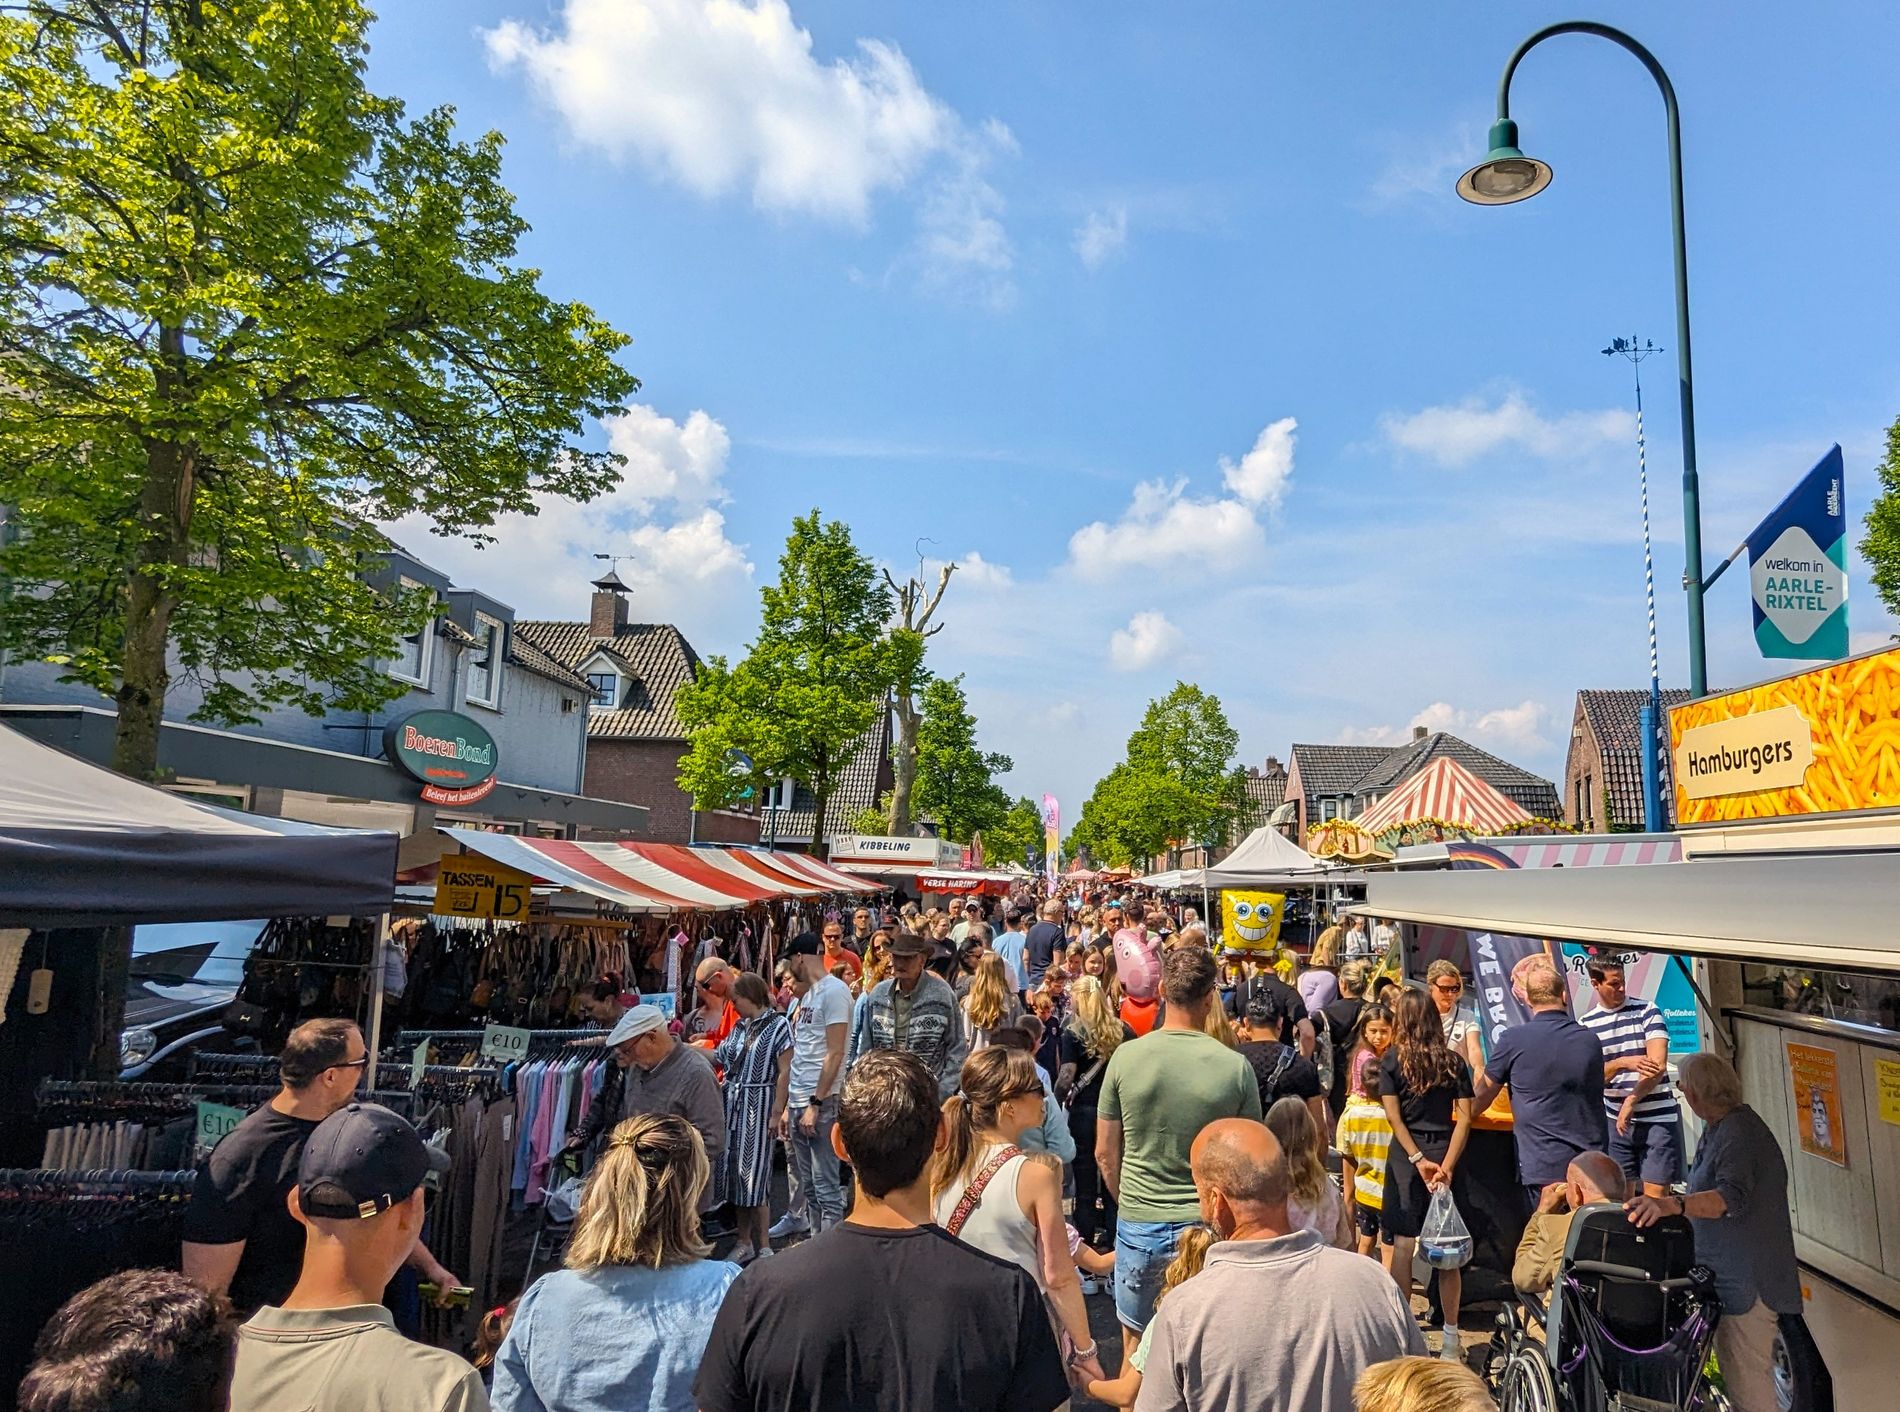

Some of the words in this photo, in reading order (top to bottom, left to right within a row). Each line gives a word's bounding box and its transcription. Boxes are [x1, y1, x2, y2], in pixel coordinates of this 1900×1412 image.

[1765, 558, 1811, 573] welkom
[1813, 560, 1824, 573] in
[1765, 577, 1834, 594] AARLE-
[1765, 594, 1828, 611] RIXTEL
[404, 725, 492, 765] BoerenBond
[1688, 740, 1793, 778] Hamburgers
[426, 788, 447, 803] Beleef
[447, 792, 459, 802] het
[859, 840, 911, 852] KIBBELING
[923, 879, 947, 888] VERSE
[947, 879, 978, 889] HARING
[442, 871, 495, 889] TASSEN
[494, 885, 524, 917] 15
[1475, 932, 1501, 977] WE
[491, 1033, 521, 1050] €10
[203, 1113, 237, 1136] €10
